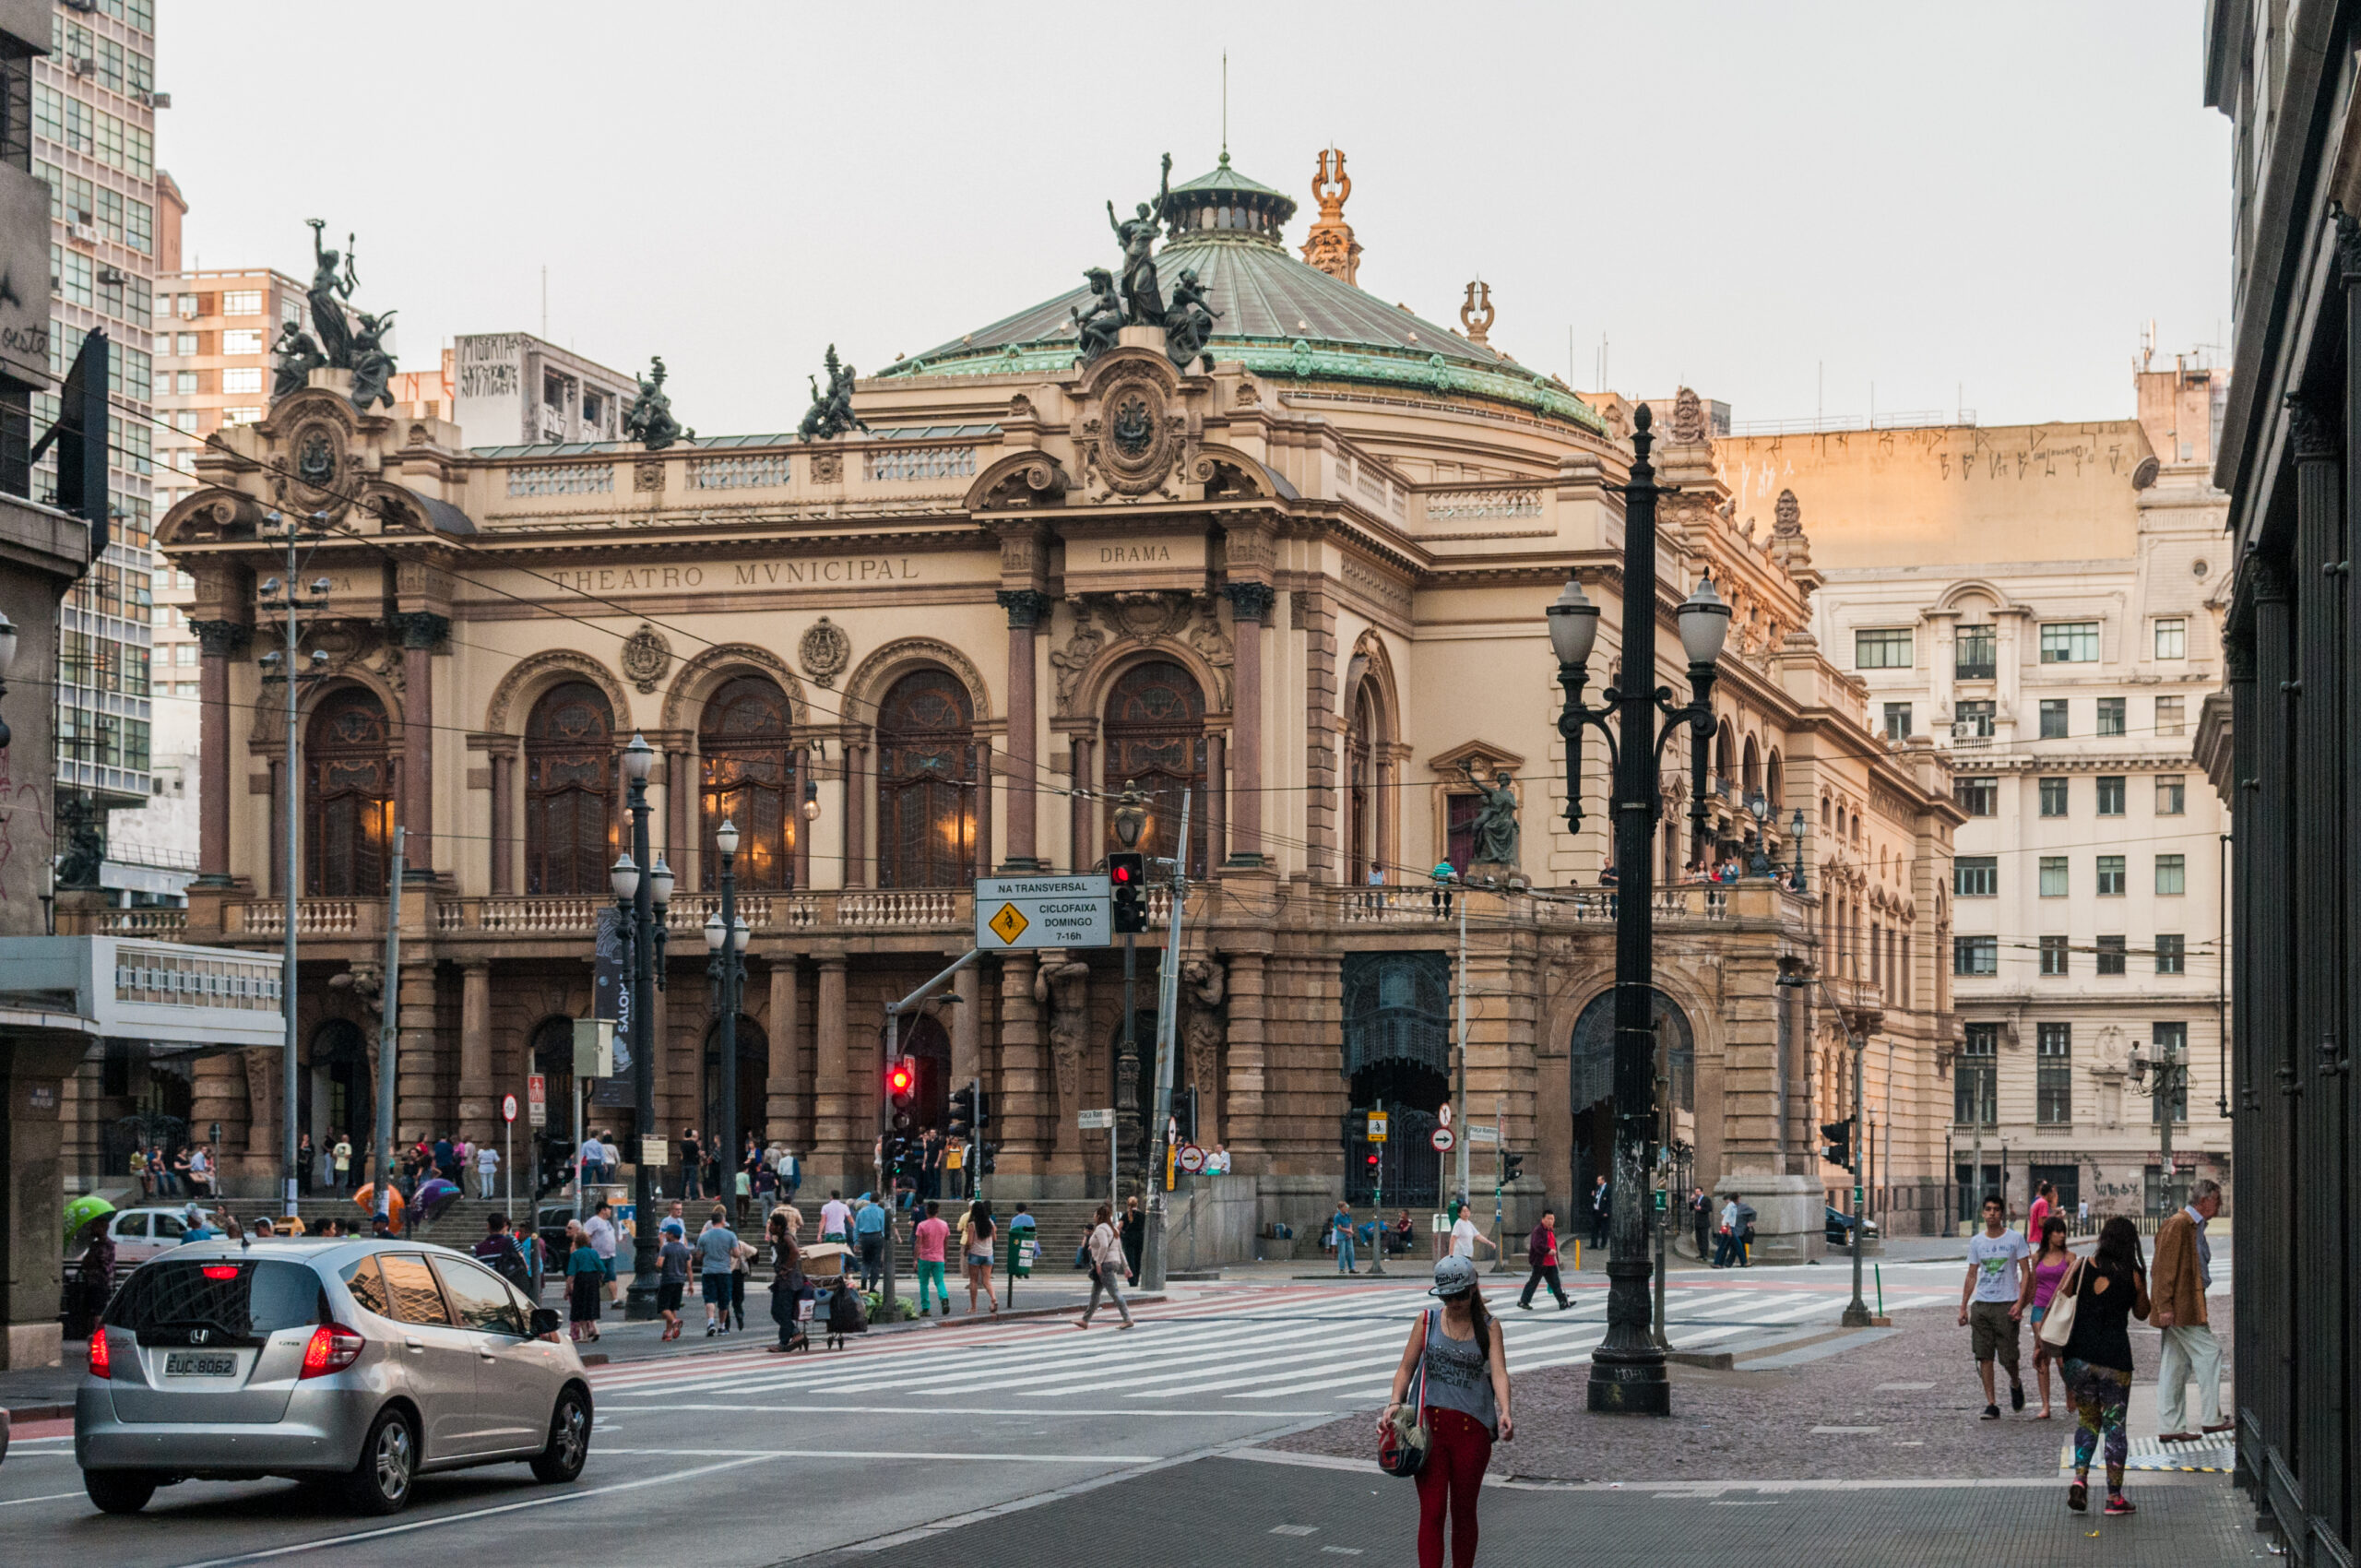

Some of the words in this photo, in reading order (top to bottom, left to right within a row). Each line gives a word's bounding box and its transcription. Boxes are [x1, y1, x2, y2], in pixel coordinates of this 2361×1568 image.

[1100, 545, 1170, 563] DRAMA
[552, 566, 704, 592] THEATRO
[734, 558, 919, 585] MVNICIPAL
[998, 885, 1013, 894] NA
[1015, 883, 1088, 893] TRANSVERSAL
[1038, 904, 1097, 913] CICLOFAIXA
[1045, 918, 1093, 927] DOMINGO
[1056, 932, 1082, 941] 7-16h
[617, 973, 630, 1033] SALOM
